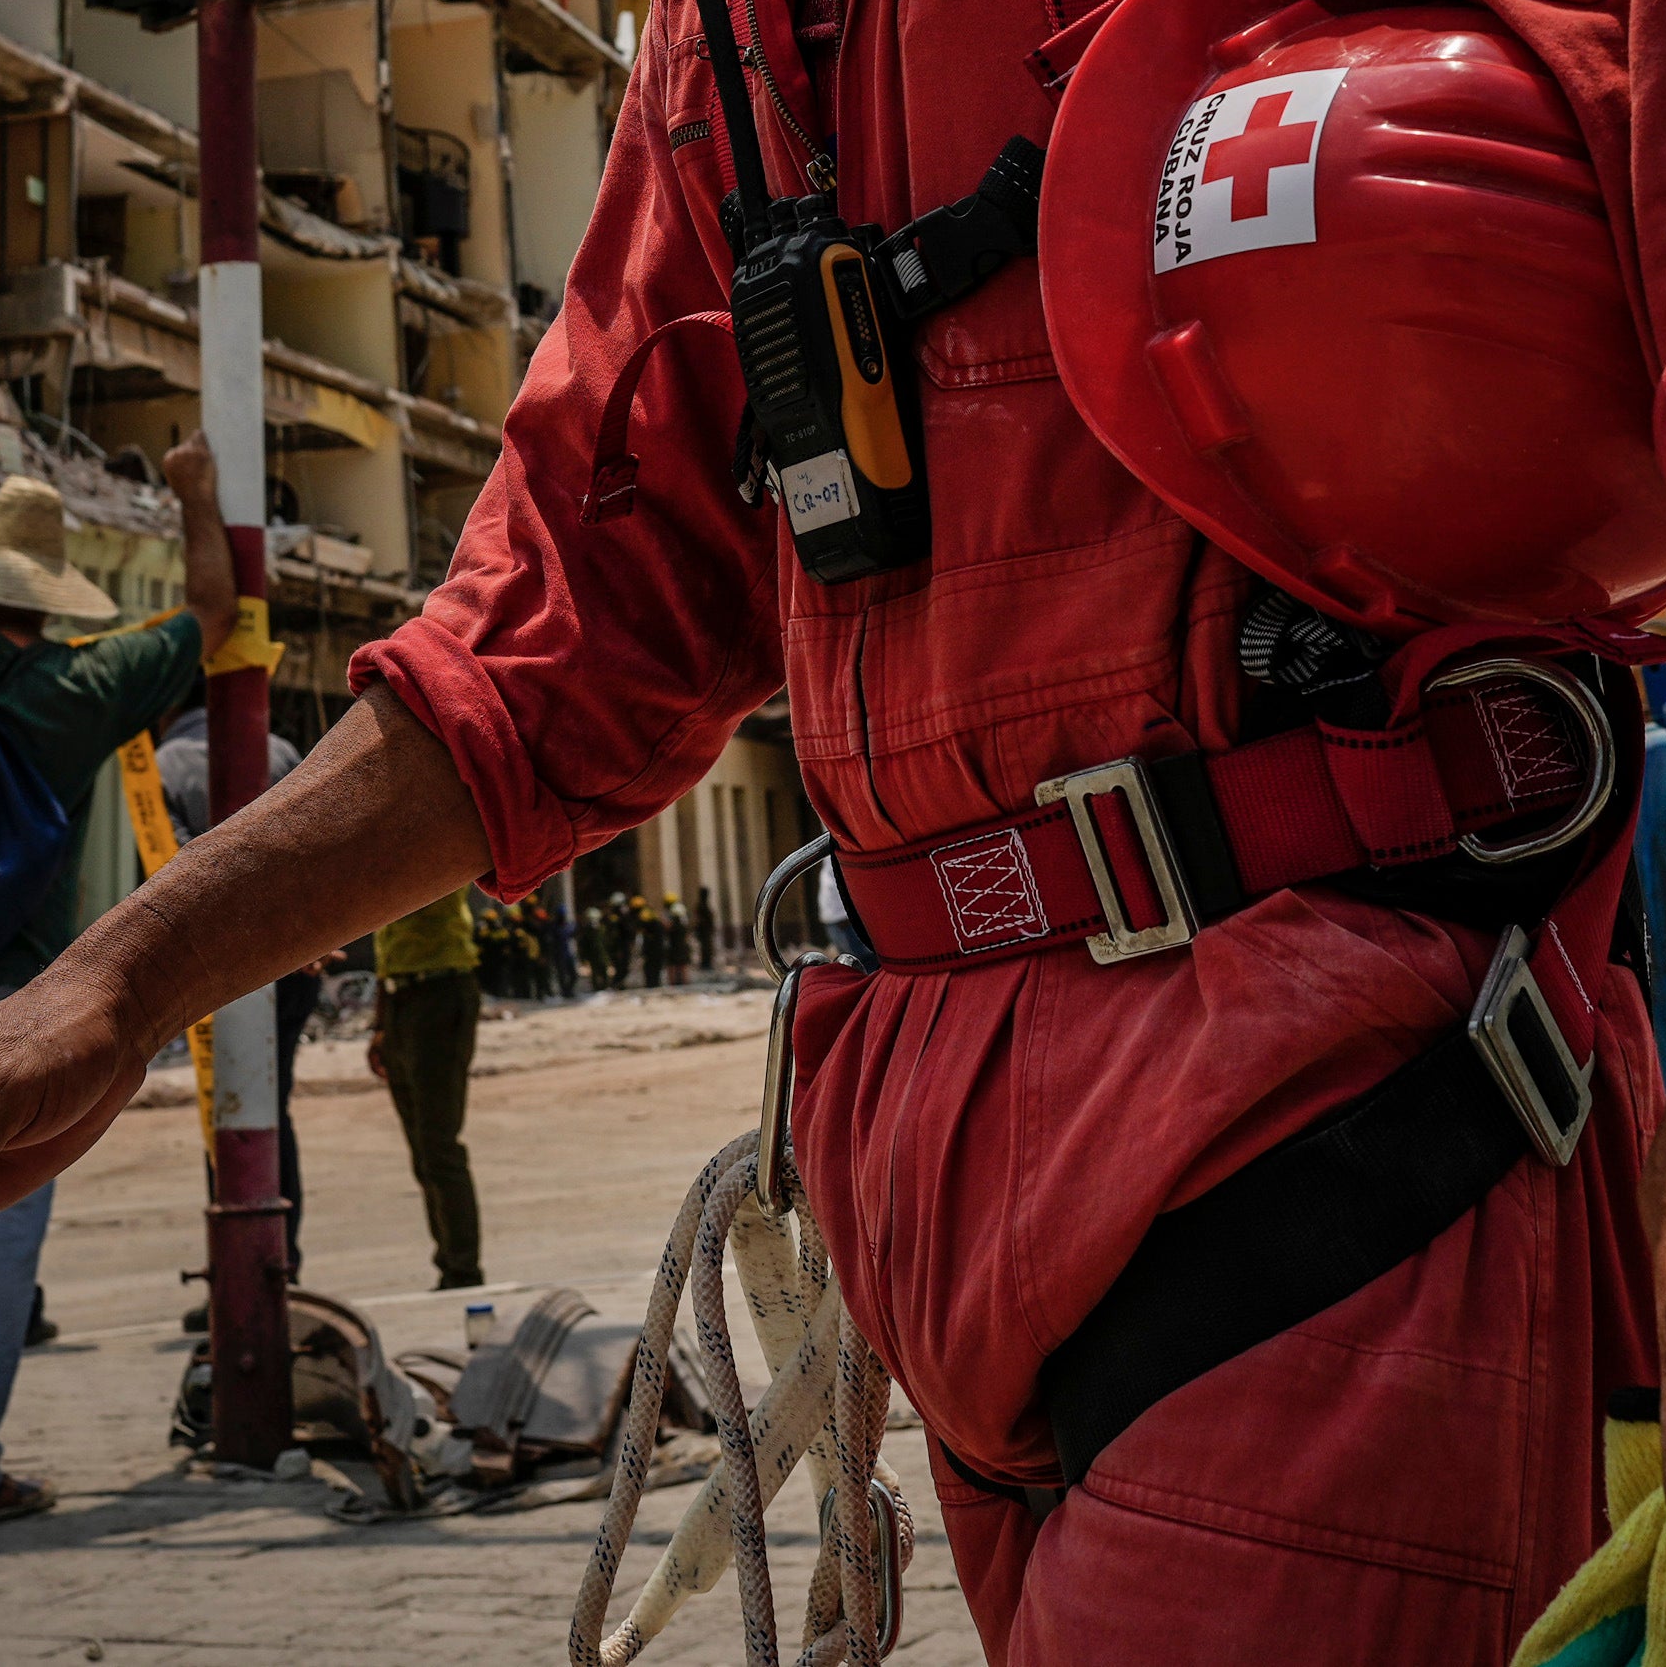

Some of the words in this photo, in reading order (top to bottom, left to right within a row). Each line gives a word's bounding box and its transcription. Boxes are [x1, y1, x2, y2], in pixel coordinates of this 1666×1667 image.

[1183, 92, 1227, 168] CRUZ
[1155, 118, 1195, 246] CUBANA
[1175, 174, 1196, 264] ROJA
[749, 254, 777, 278] HYT
